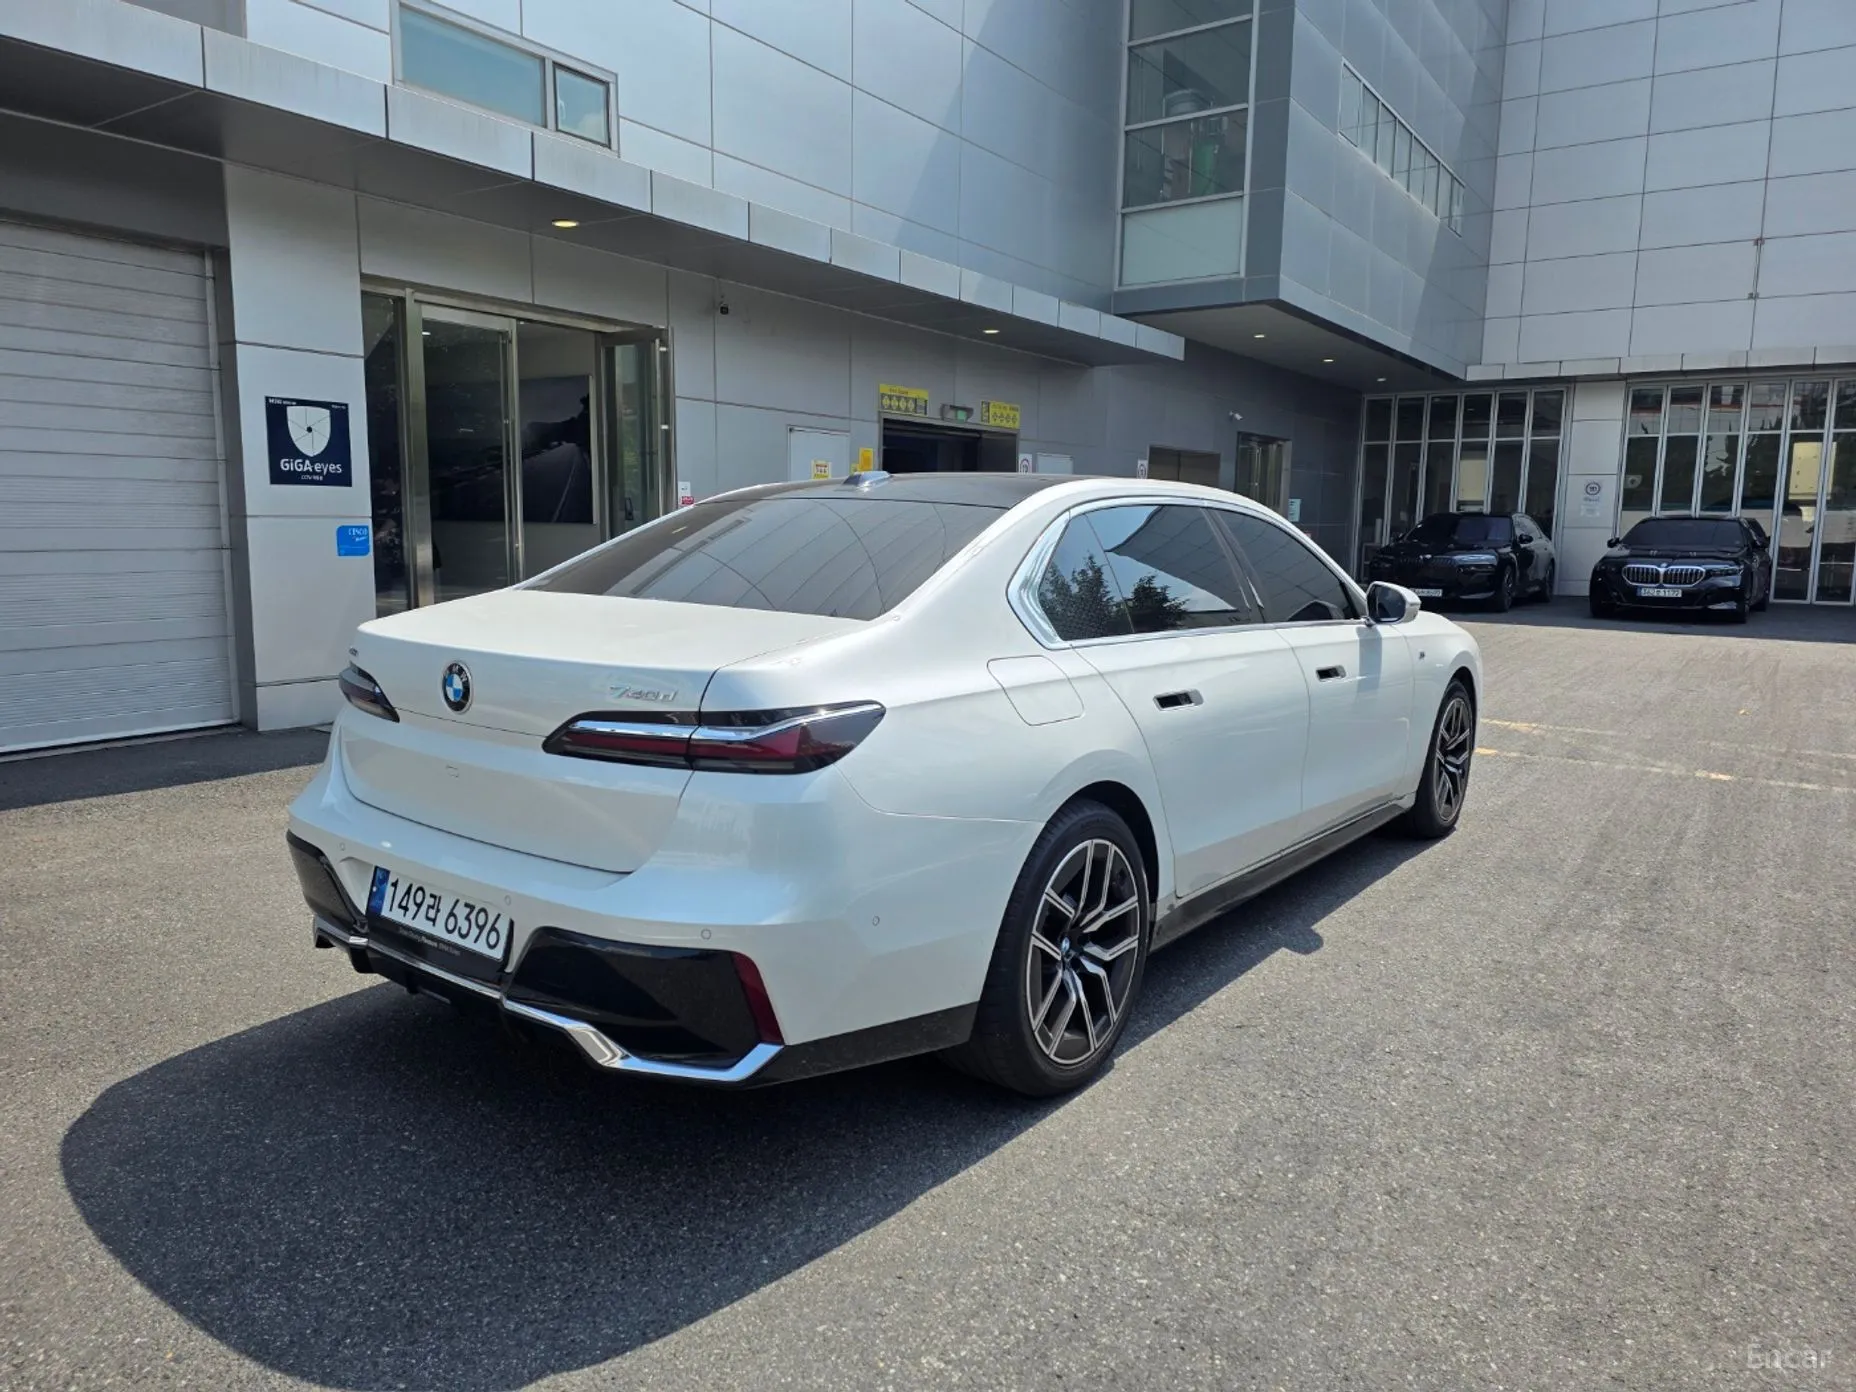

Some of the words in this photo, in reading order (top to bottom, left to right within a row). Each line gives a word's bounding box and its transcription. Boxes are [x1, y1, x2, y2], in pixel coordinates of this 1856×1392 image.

[280, 458, 312, 472] GiGA
[314, 462, 342, 476] eyes
[389, 877, 442, 927] 149라
[444, 898, 502, 950] 6396
